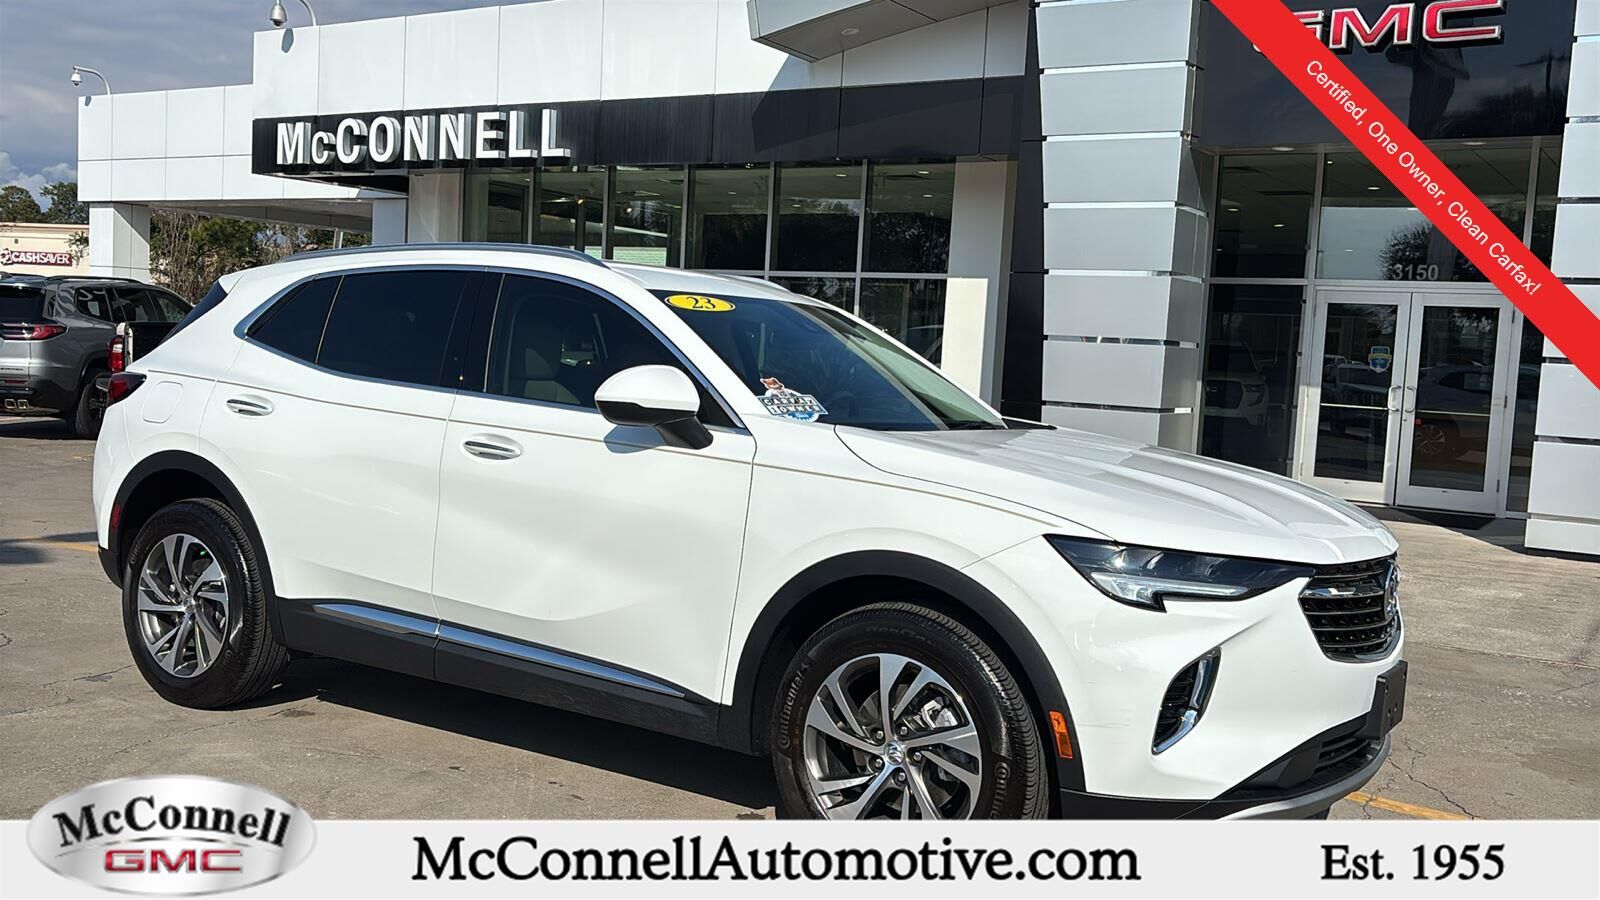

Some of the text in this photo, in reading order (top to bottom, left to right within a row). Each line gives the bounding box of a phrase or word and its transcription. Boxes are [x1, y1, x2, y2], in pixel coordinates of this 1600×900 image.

[276, 108, 571, 165] McCONNELL
[1391, 263, 1439, 281] 3150
[685, 296, 717, 310] 23
